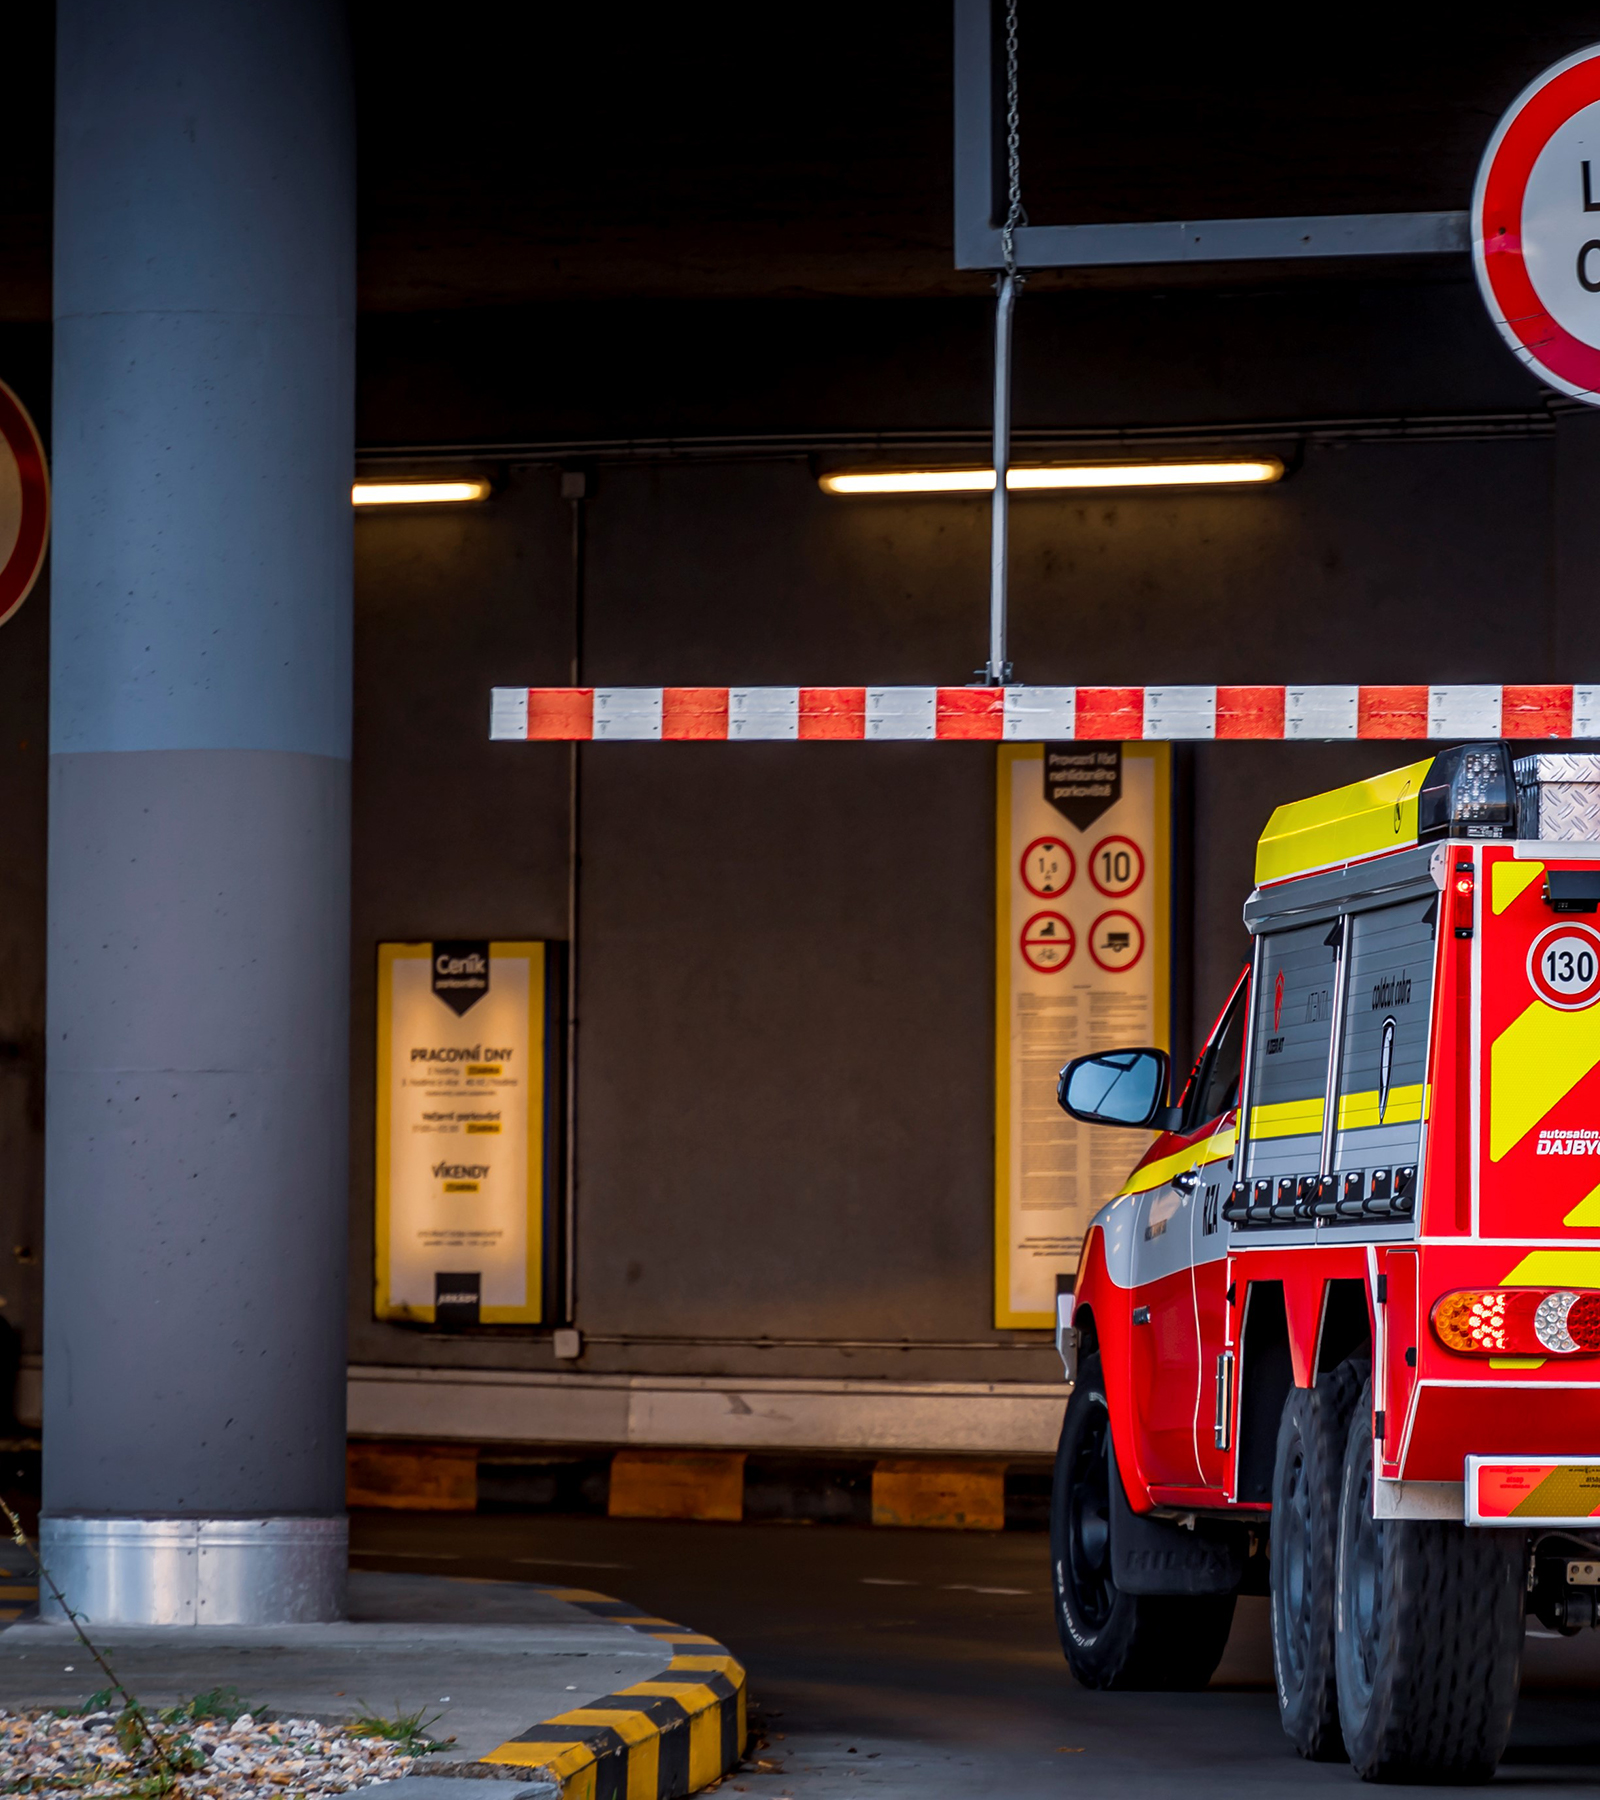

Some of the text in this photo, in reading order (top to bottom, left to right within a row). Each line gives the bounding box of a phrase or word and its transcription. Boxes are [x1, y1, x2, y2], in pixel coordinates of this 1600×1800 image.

[1101, 851, 1131, 888] 10
[1546, 950, 1595, 983] 130
[410, 1044, 514, 1062] PRACOVNÍ DNY
[1539, 1128, 1599, 1140] autosalon
[432, 1160, 491, 1179] VÍKENDY
